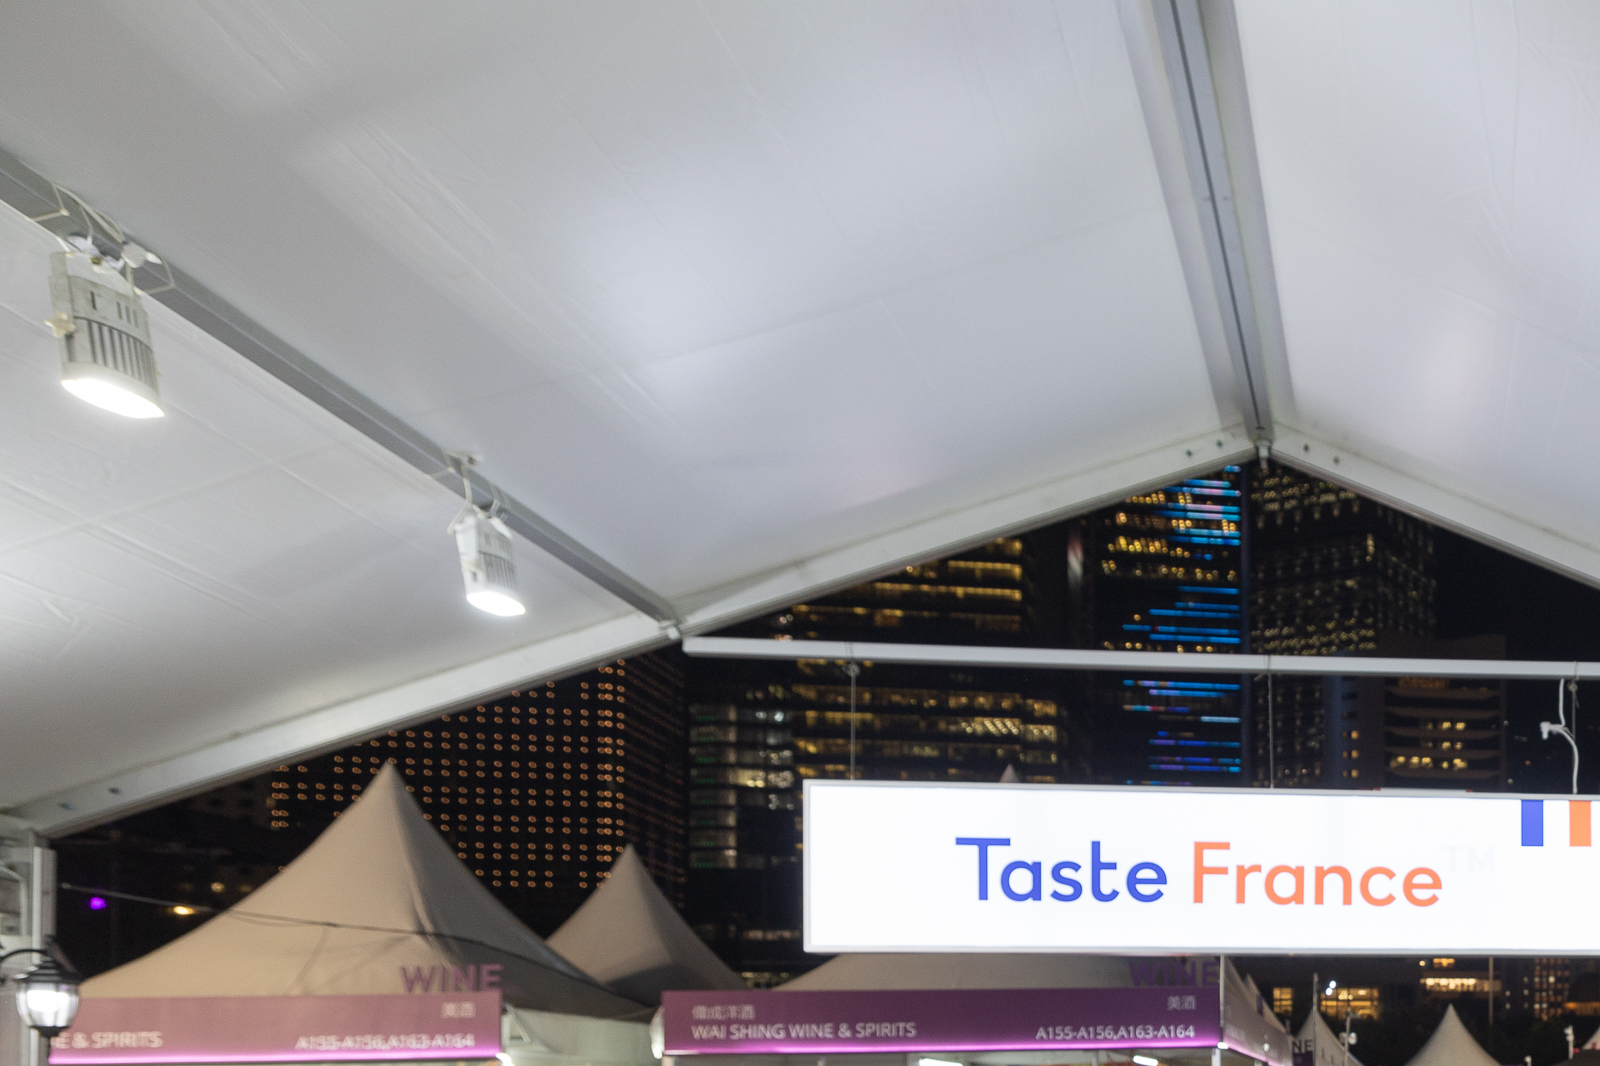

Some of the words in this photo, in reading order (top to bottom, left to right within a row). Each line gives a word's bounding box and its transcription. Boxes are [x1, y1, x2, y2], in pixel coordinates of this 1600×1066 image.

[956, 837, 1168, 903] Taste
[1191, 841, 1443, 908] France
[401, 964, 503, 992] WINE
[1127, 959, 1220, 987] WINE
[71, 1032, 89, 1049] &
[91, 1031, 164, 1048] SPIRITS
[691, 1025, 727, 1040] WAI
[729, 1023, 786, 1040] SHING
[788, 1023, 833, 1039] WINE
[837, 1022, 852, 1038] &
[855, 1022, 917, 1038] SPIRITS
[1035, 1024, 1196, 1041] A155-A156,A163-A164
